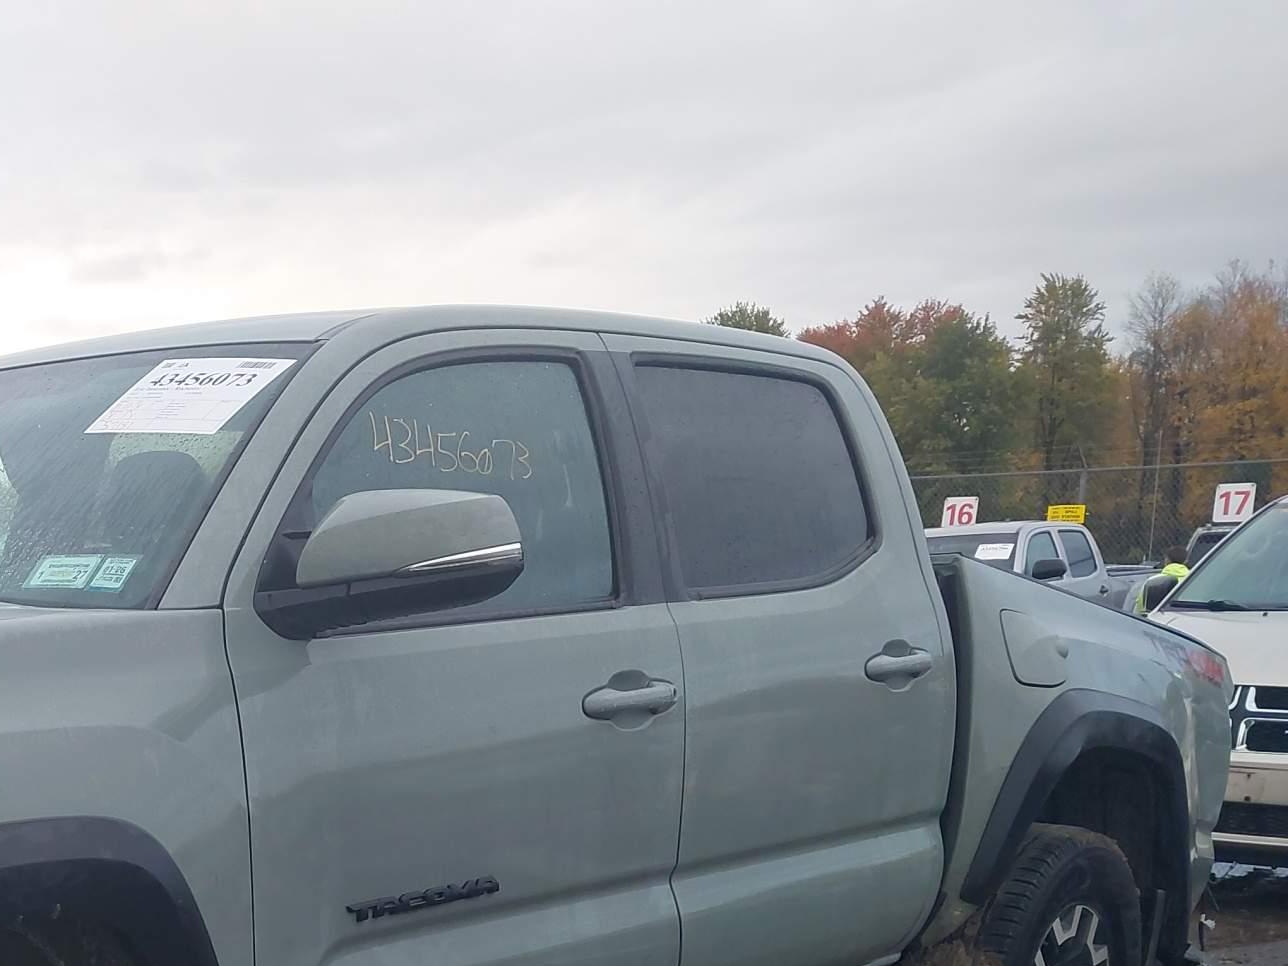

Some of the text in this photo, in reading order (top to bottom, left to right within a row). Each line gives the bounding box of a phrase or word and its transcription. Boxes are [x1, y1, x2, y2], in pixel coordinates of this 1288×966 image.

[150, 372, 258, 387] 43456073
[369, 411, 533, 480] 43456073
[945, 503, 974, 526] 16
[1219, 490, 1251, 516] 17
[72, 569, 89, 581] 27
